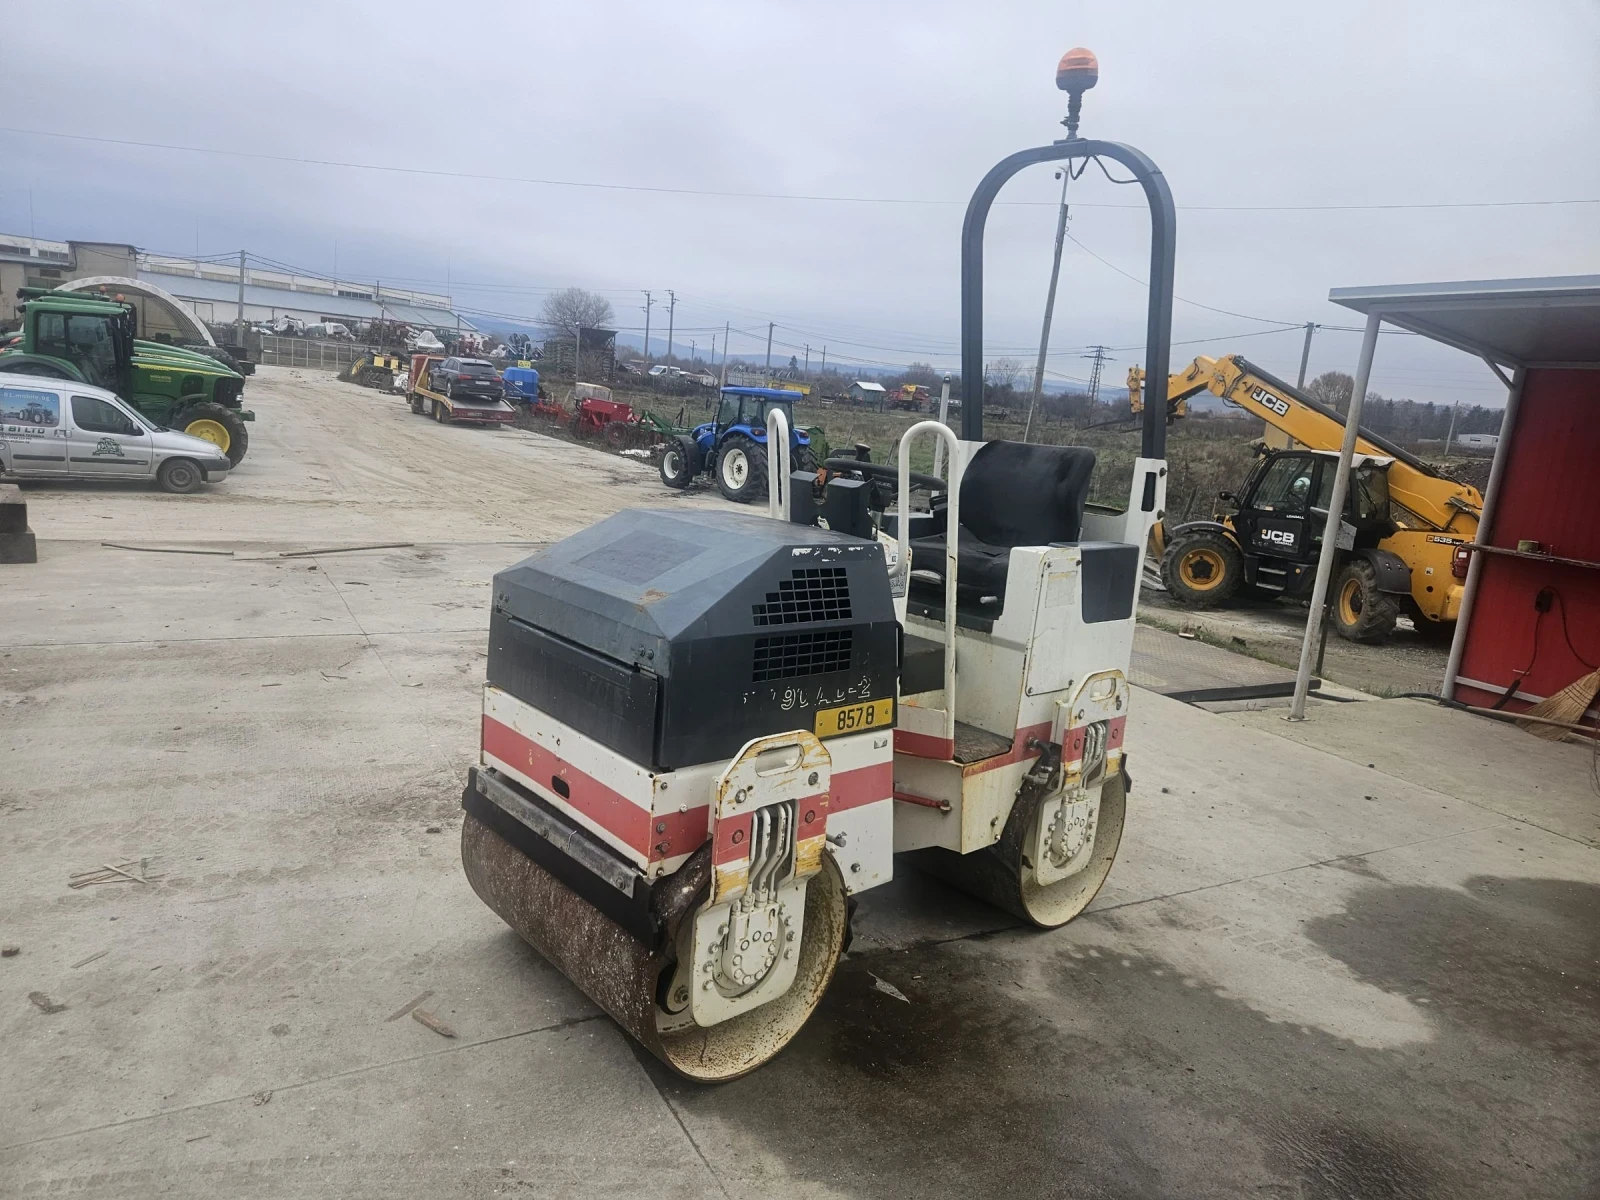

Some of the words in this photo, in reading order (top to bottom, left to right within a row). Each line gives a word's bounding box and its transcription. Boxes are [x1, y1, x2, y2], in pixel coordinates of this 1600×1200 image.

[1252, 390, 1289, 415] JCB
[1261, 529, 1294, 543] JCB
[837, 705, 875, 730] 8578
